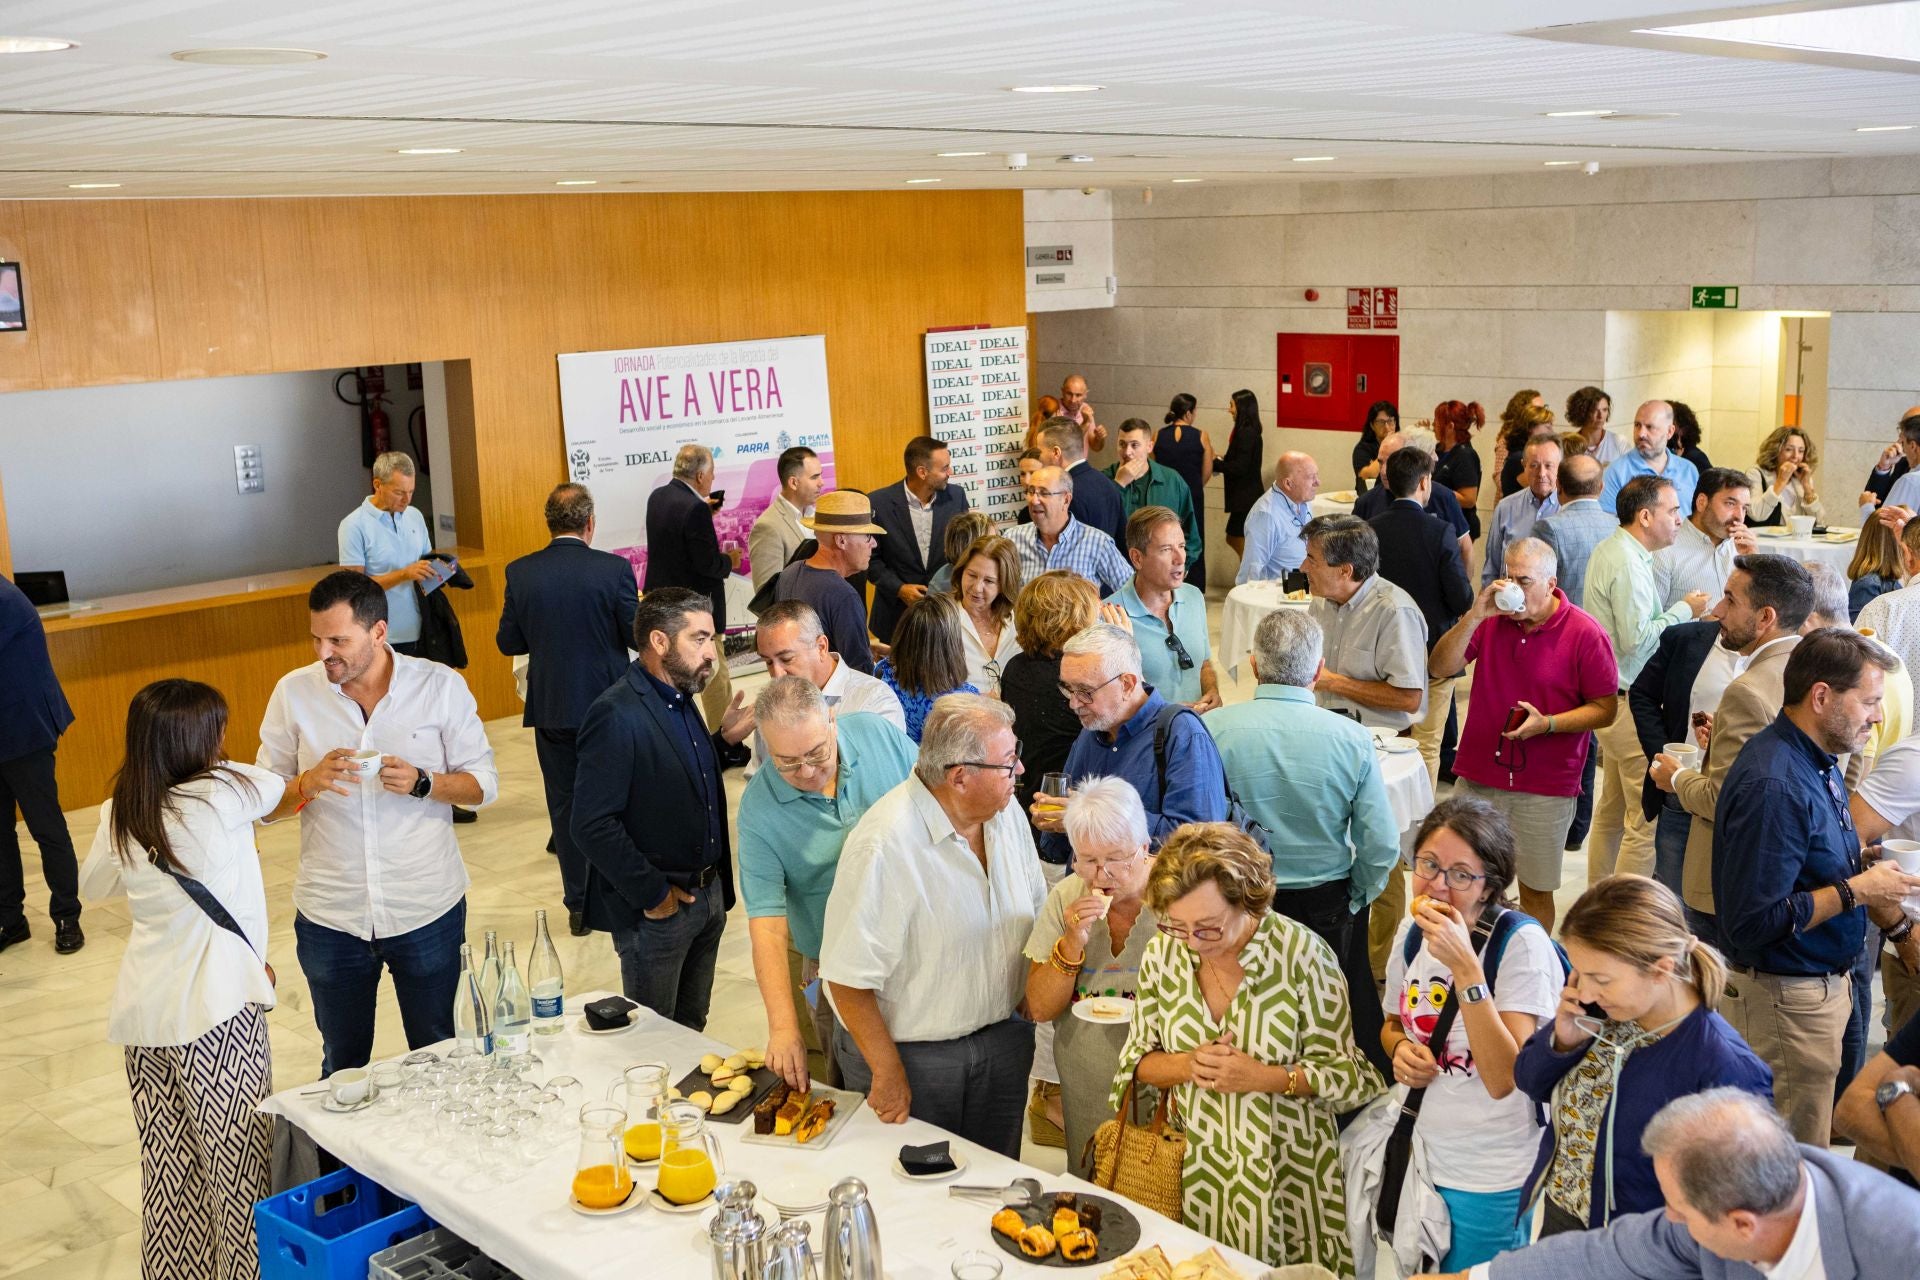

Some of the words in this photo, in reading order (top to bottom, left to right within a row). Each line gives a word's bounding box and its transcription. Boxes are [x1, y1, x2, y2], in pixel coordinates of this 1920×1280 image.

[930, 340, 971, 353] IDEAL
[980, 337, 1019, 349] IDEAL
[614, 354, 655, 373] JORNADA
[932, 358, 972, 371] IDEAL
[981, 354, 1020, 366] IDEAL
[933, 376, 973, 389] IDEAL
[982, 372, 1020, 384] IDEAL
[620, 375, 673, 423] AVE
[684, 373, 701, 417] A
[709, 366, 783, 413] VERA
[934, 393, 974, 406] IDEAL
[983, 389, 1021, 401] IDEAL
[935, 411, 975, 424] IDEAL
[984, 406, 1022, 419] IDEAL
[985, 423, 1022, 436] IDEAL
[807, 433, 829, 442] PLAYA
[736, 442, 770, 454] PARRA
[985, 441, 1023, 454] IDEAL
[625, 450, 672, 467] IDEAL
[986, 459, 1019, 471] IDEA
[953, 463, 977, 475] EAL
